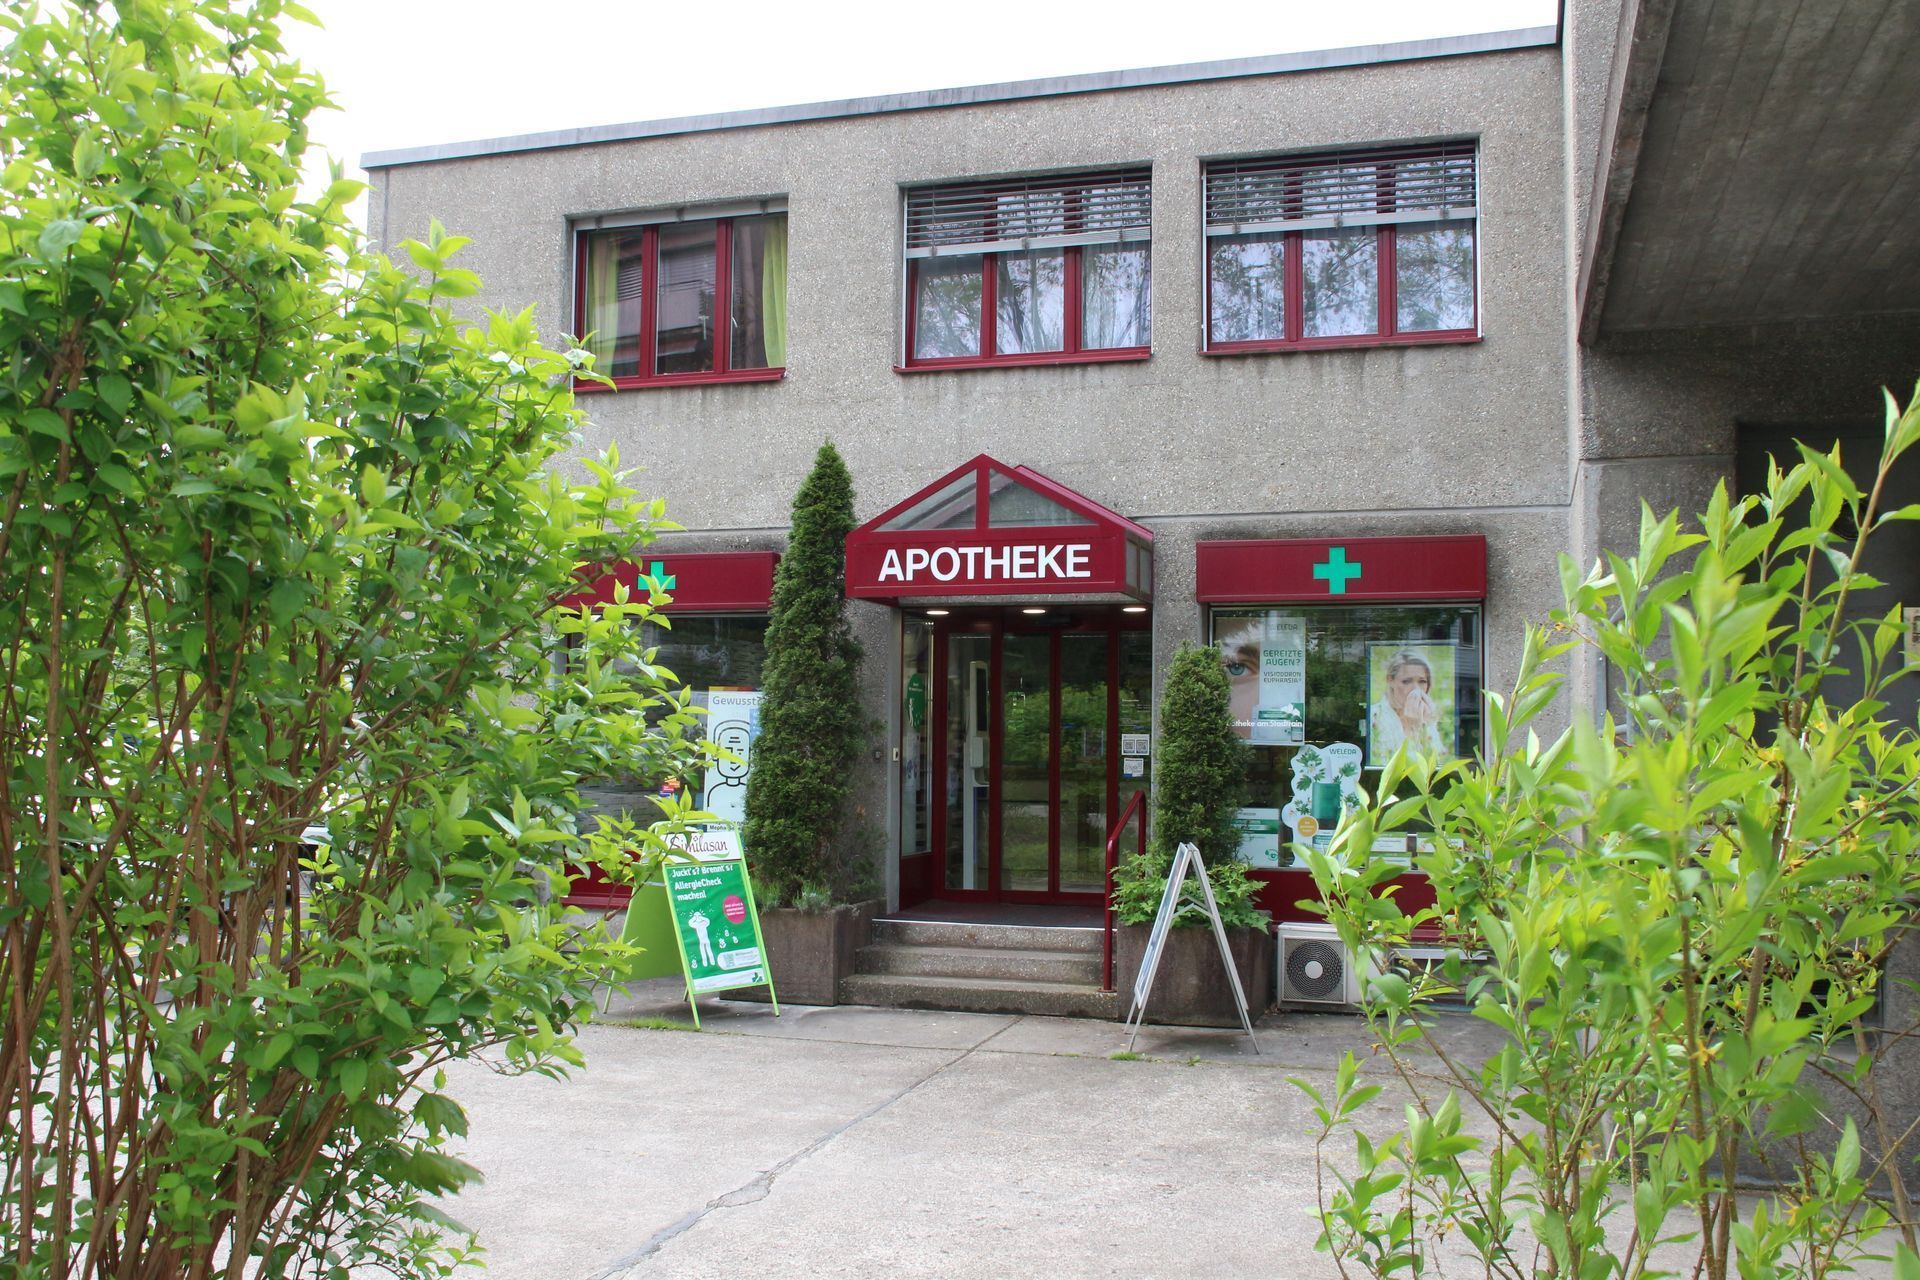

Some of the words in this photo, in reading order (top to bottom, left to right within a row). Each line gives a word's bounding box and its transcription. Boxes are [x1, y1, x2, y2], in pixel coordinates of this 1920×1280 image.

[877, 543, 1091, 582] APOTHEKE
[1263, 649, 1303, 658] GEREIZTE
[1265, 658, 1301, 666] AUGEN?
[675, 878, 722, 890] AllergieCheck
[677, 890, 706, 900] machen!
